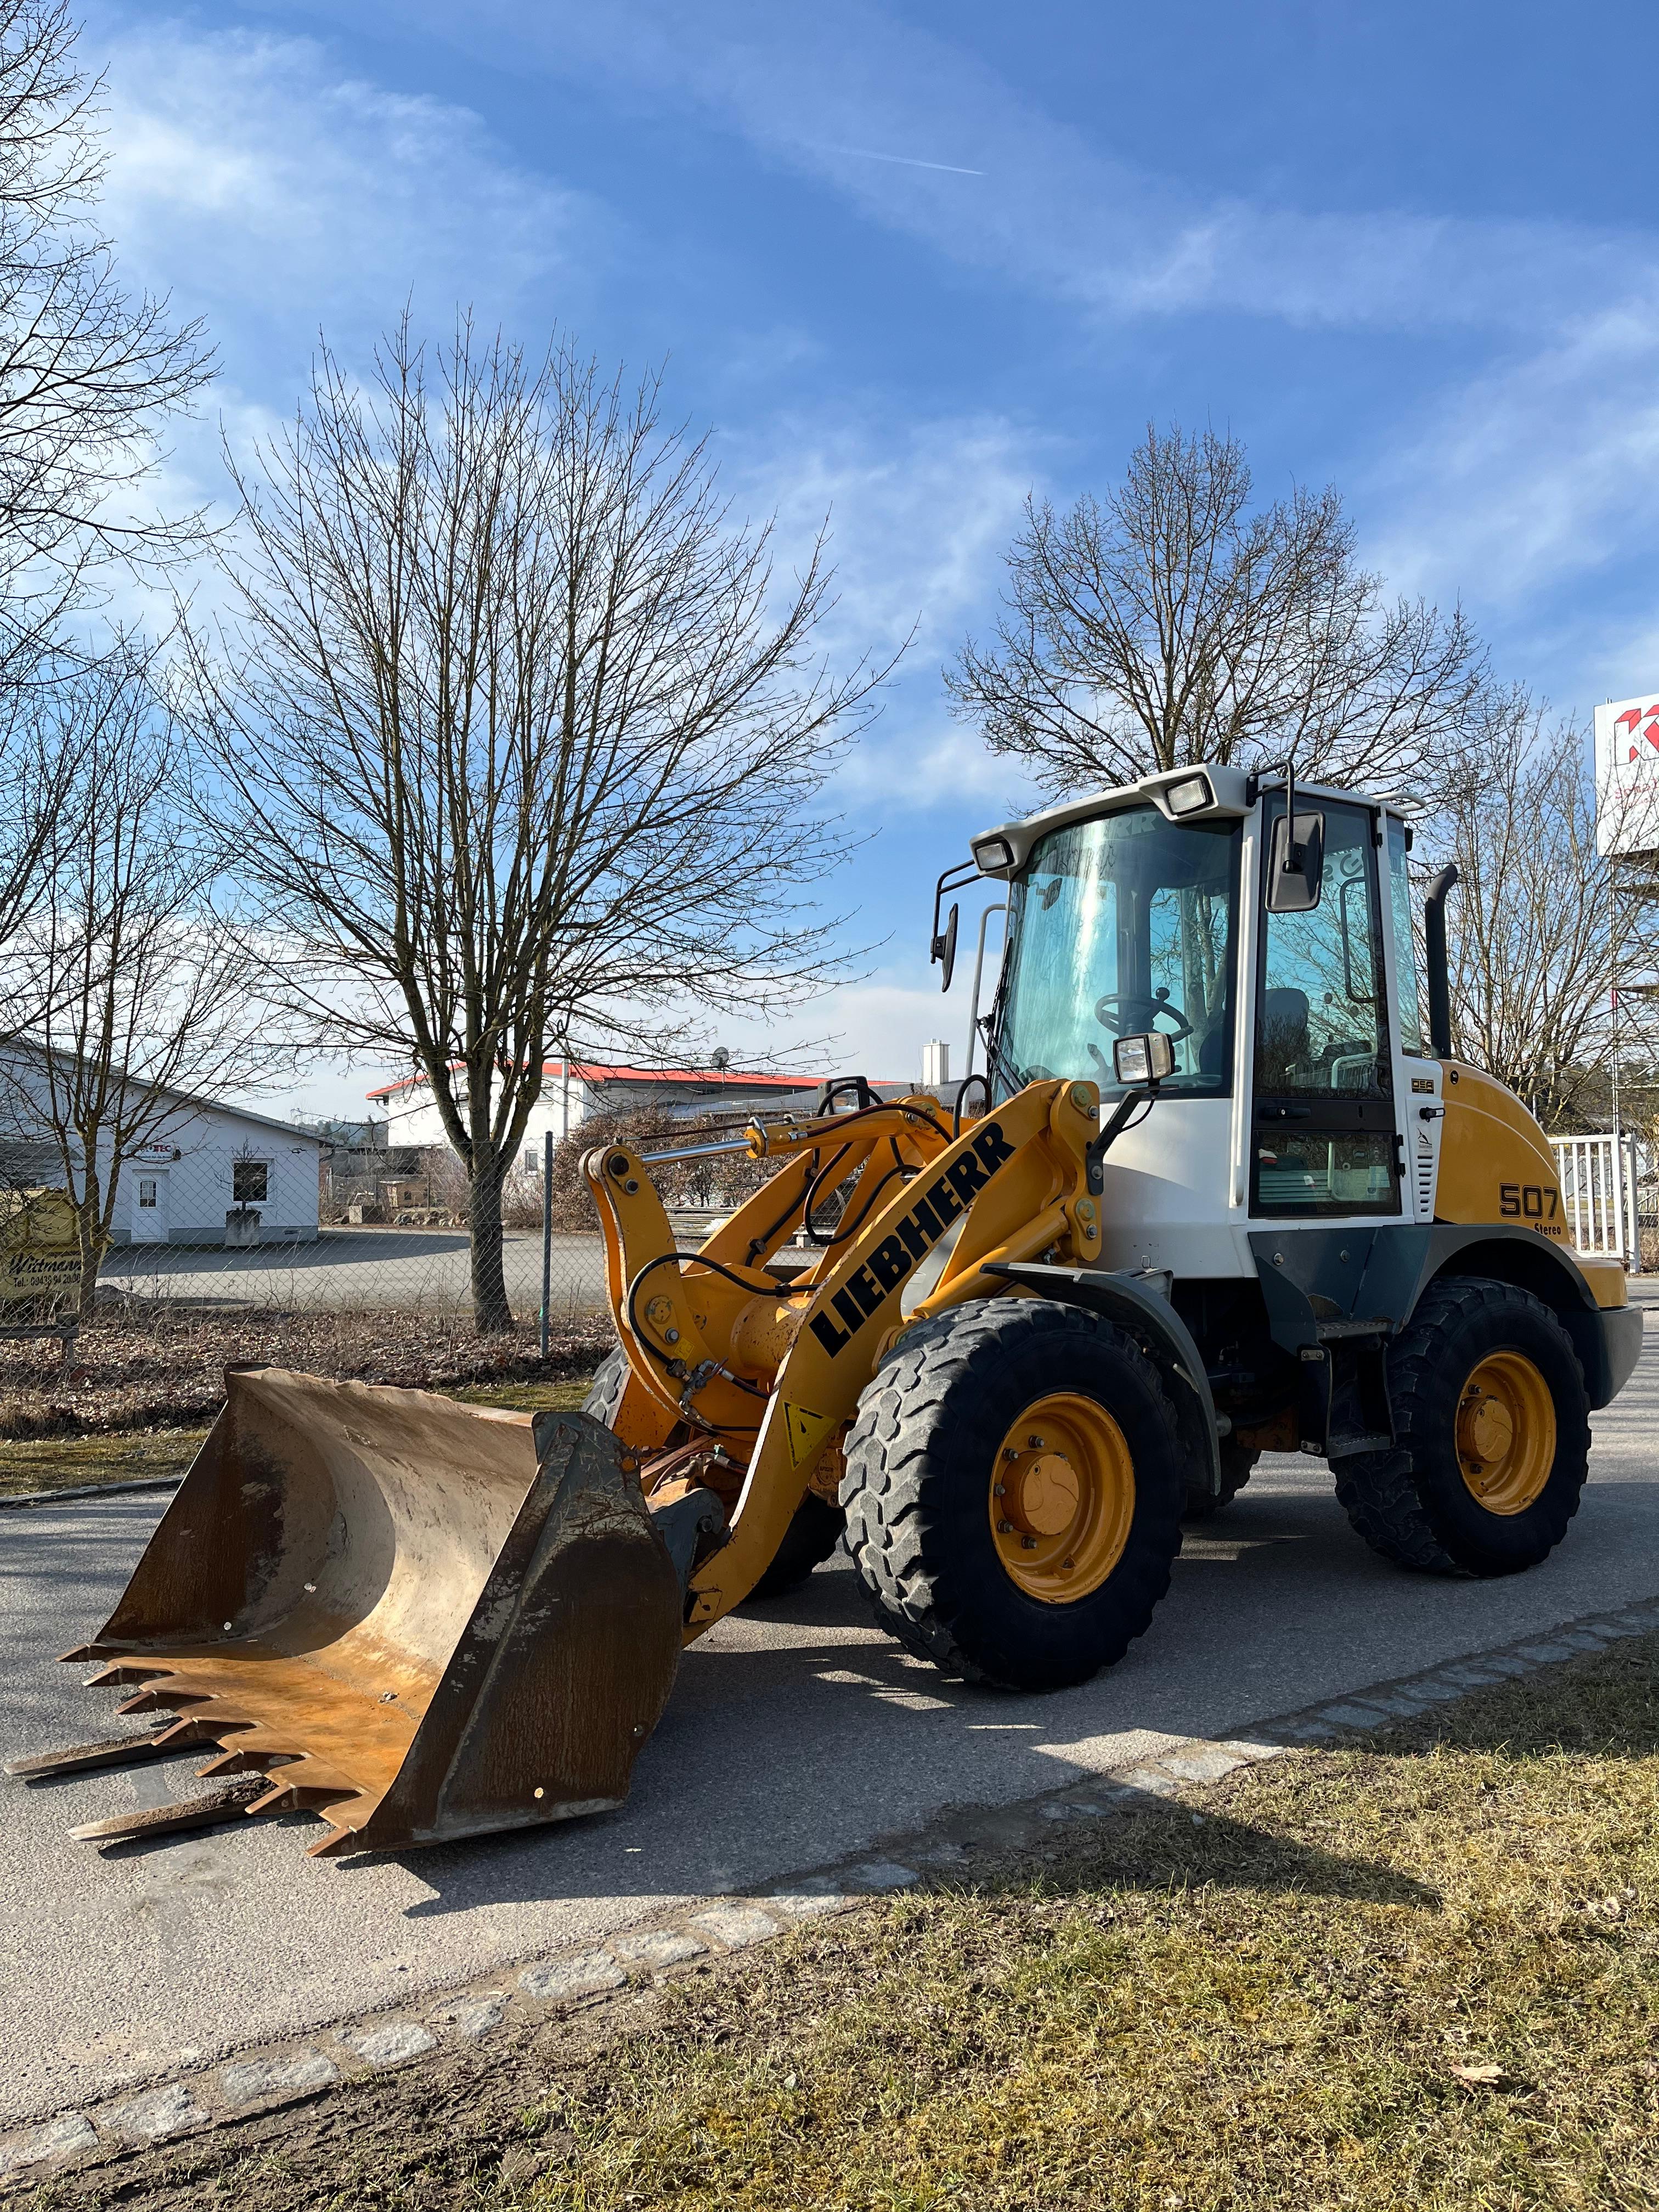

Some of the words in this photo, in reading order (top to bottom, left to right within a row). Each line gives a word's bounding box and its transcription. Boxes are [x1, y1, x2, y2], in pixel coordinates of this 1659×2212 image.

[1500, 1182, 1558, 1220] 507
[809, 1122, 1017, 1359] LIEBHERR
[1534, 1222, 1561, 1235] Stereo
